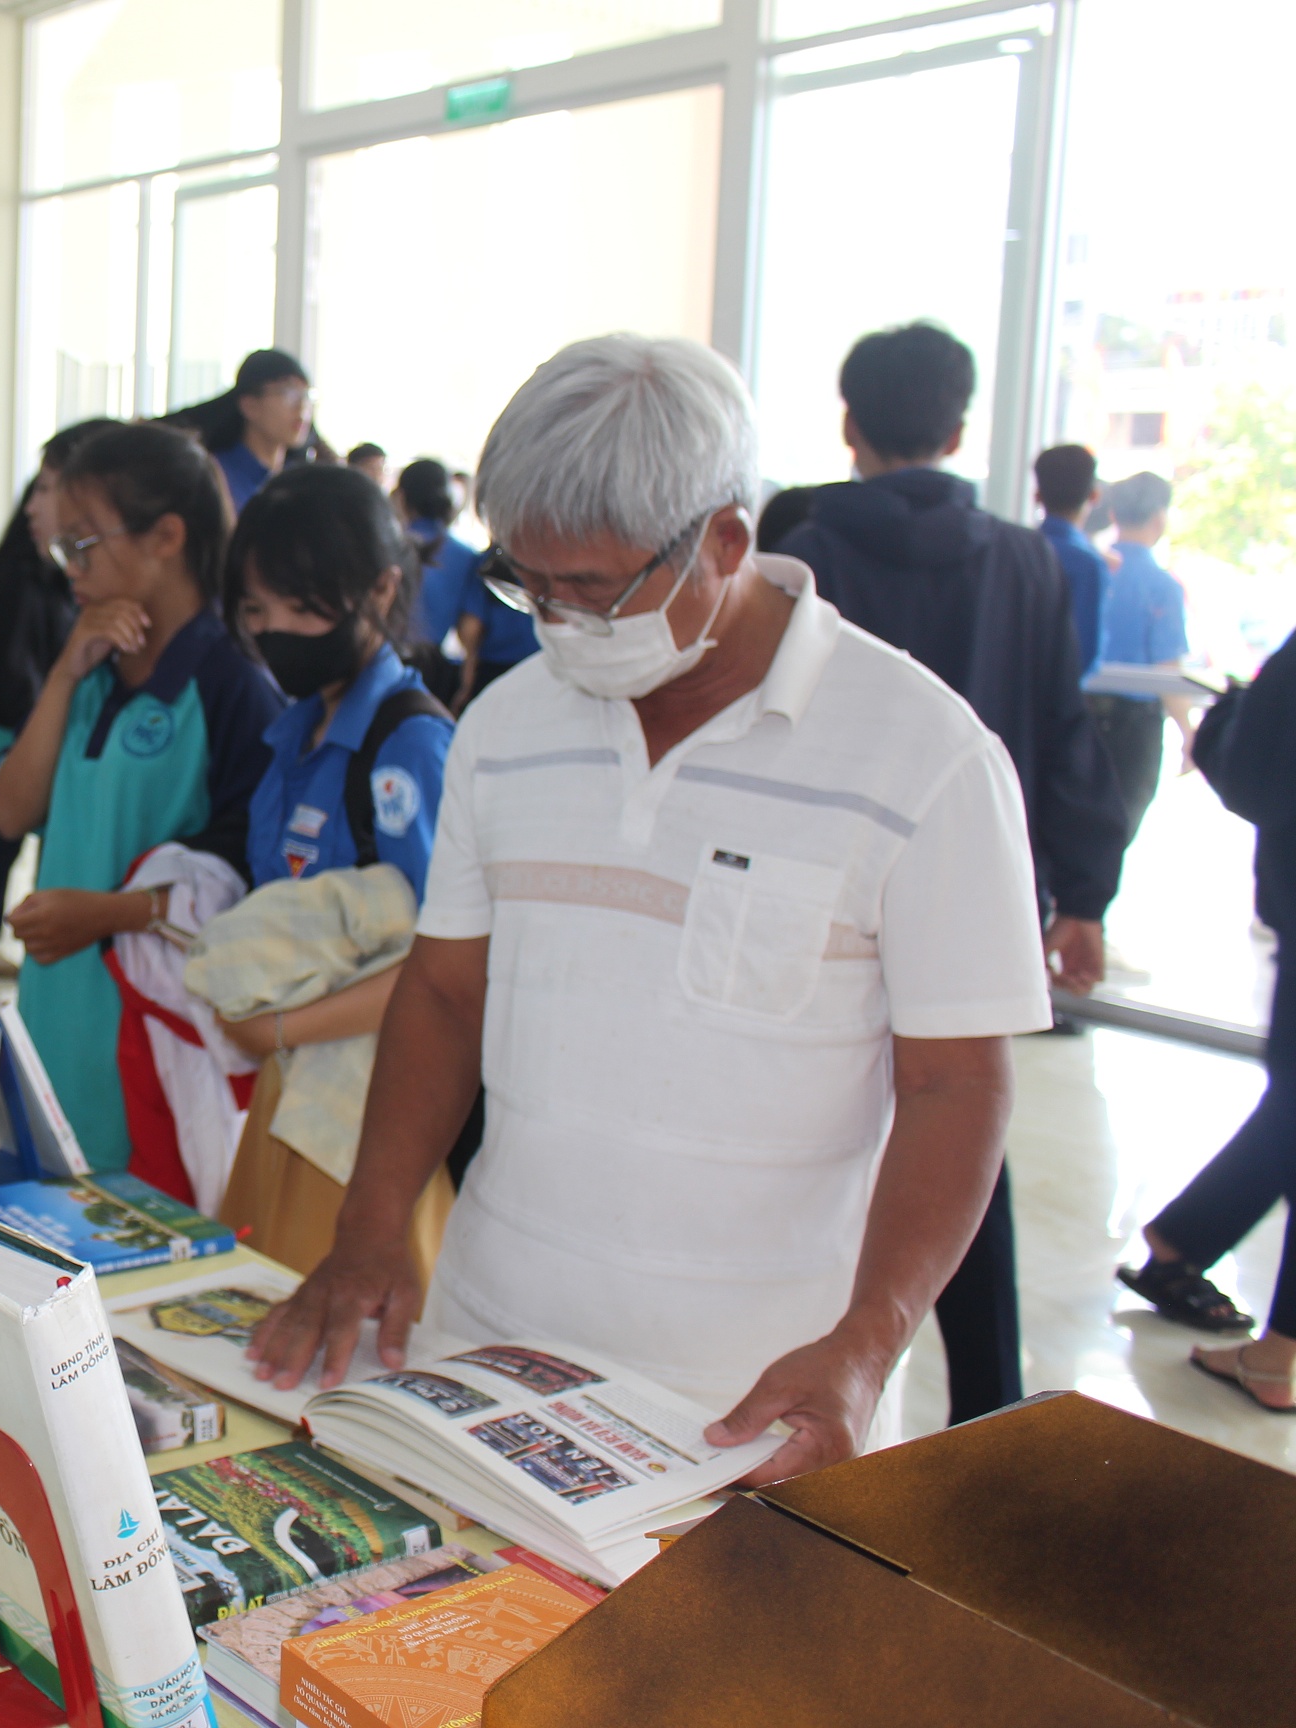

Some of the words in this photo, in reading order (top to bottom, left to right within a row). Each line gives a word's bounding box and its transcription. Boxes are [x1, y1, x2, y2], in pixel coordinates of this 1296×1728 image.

[51, 1351, 83, 1376] UBND
[84, 1332, 105, 1355] TỈNH
[51, 1369, 80, 1391] LÂM
[81, 1344, 110, 1374] ĐỒNG
[103, 1551, 133, 1569] ĐỊA
[136, 1528, 159, 1553] CHÍ
[90, 1569, 132, 1592] LÂM
[133, 1687, 156, 1699] NXB
[157, 1674, 179, 1692] VĂN
[150, 1693, 173, 1709] DÂN
[305, 1692, 329, 1715] QUANG
